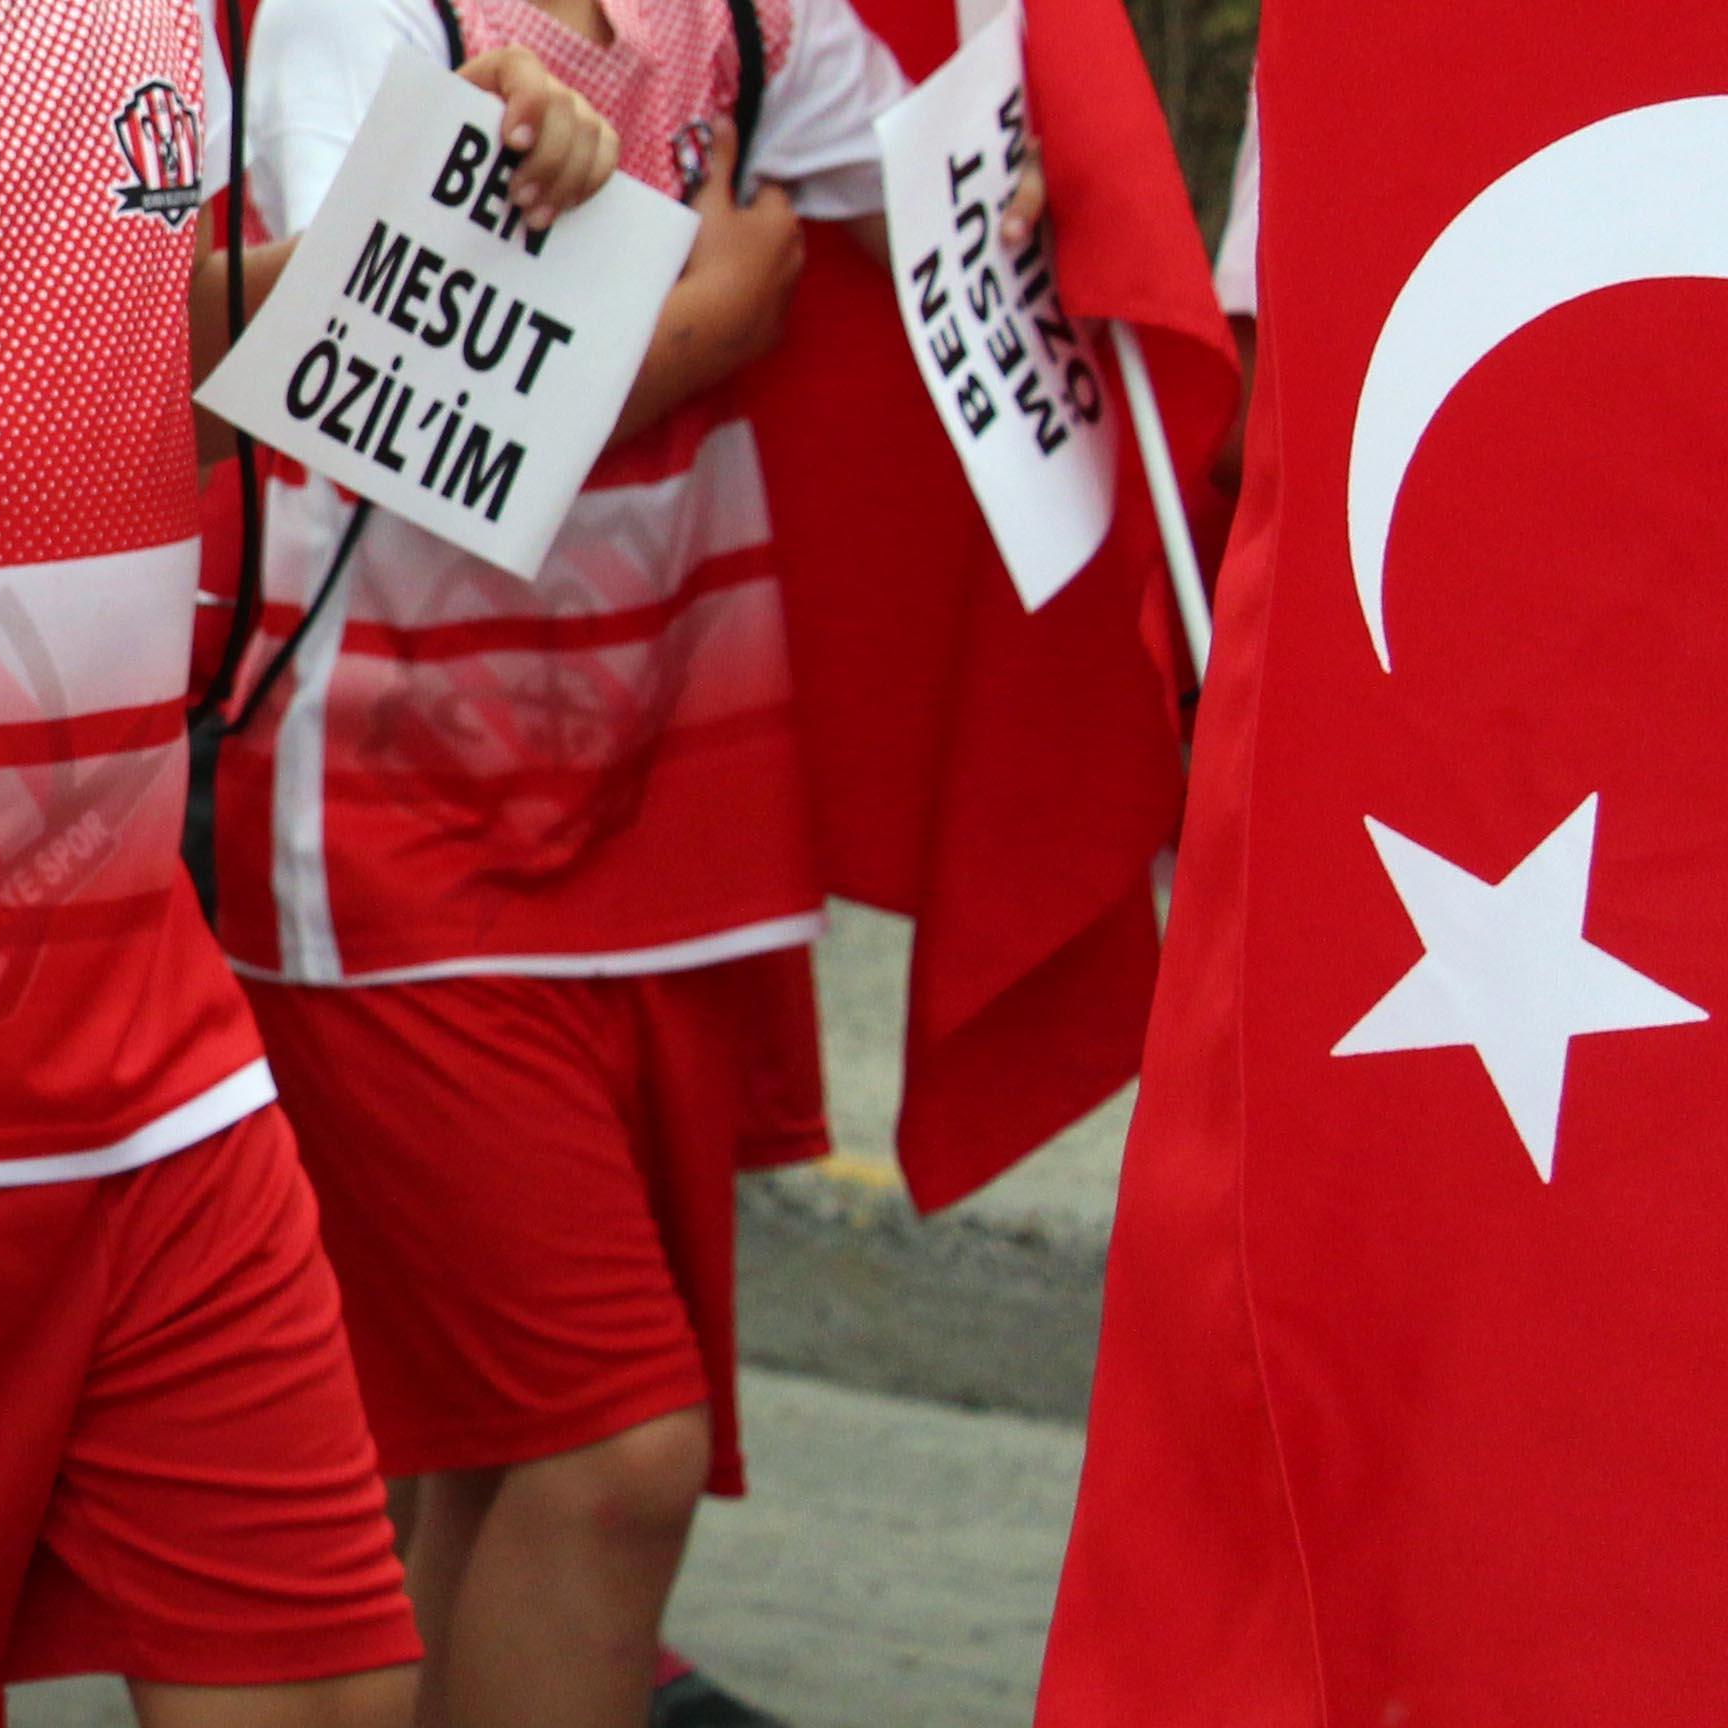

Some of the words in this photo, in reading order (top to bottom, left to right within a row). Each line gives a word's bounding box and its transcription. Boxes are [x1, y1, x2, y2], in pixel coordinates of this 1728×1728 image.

[343, 219, 575, 396] MESUT
[913, 248, 996, 439] BEN
[949, 151, 1068, 457] MESUT
[997, 86, 1103, 426] ÖZİLM
[285, 318, 527, 524] ÖZİL'İM
[34, 809, 111, 893] SPOR
